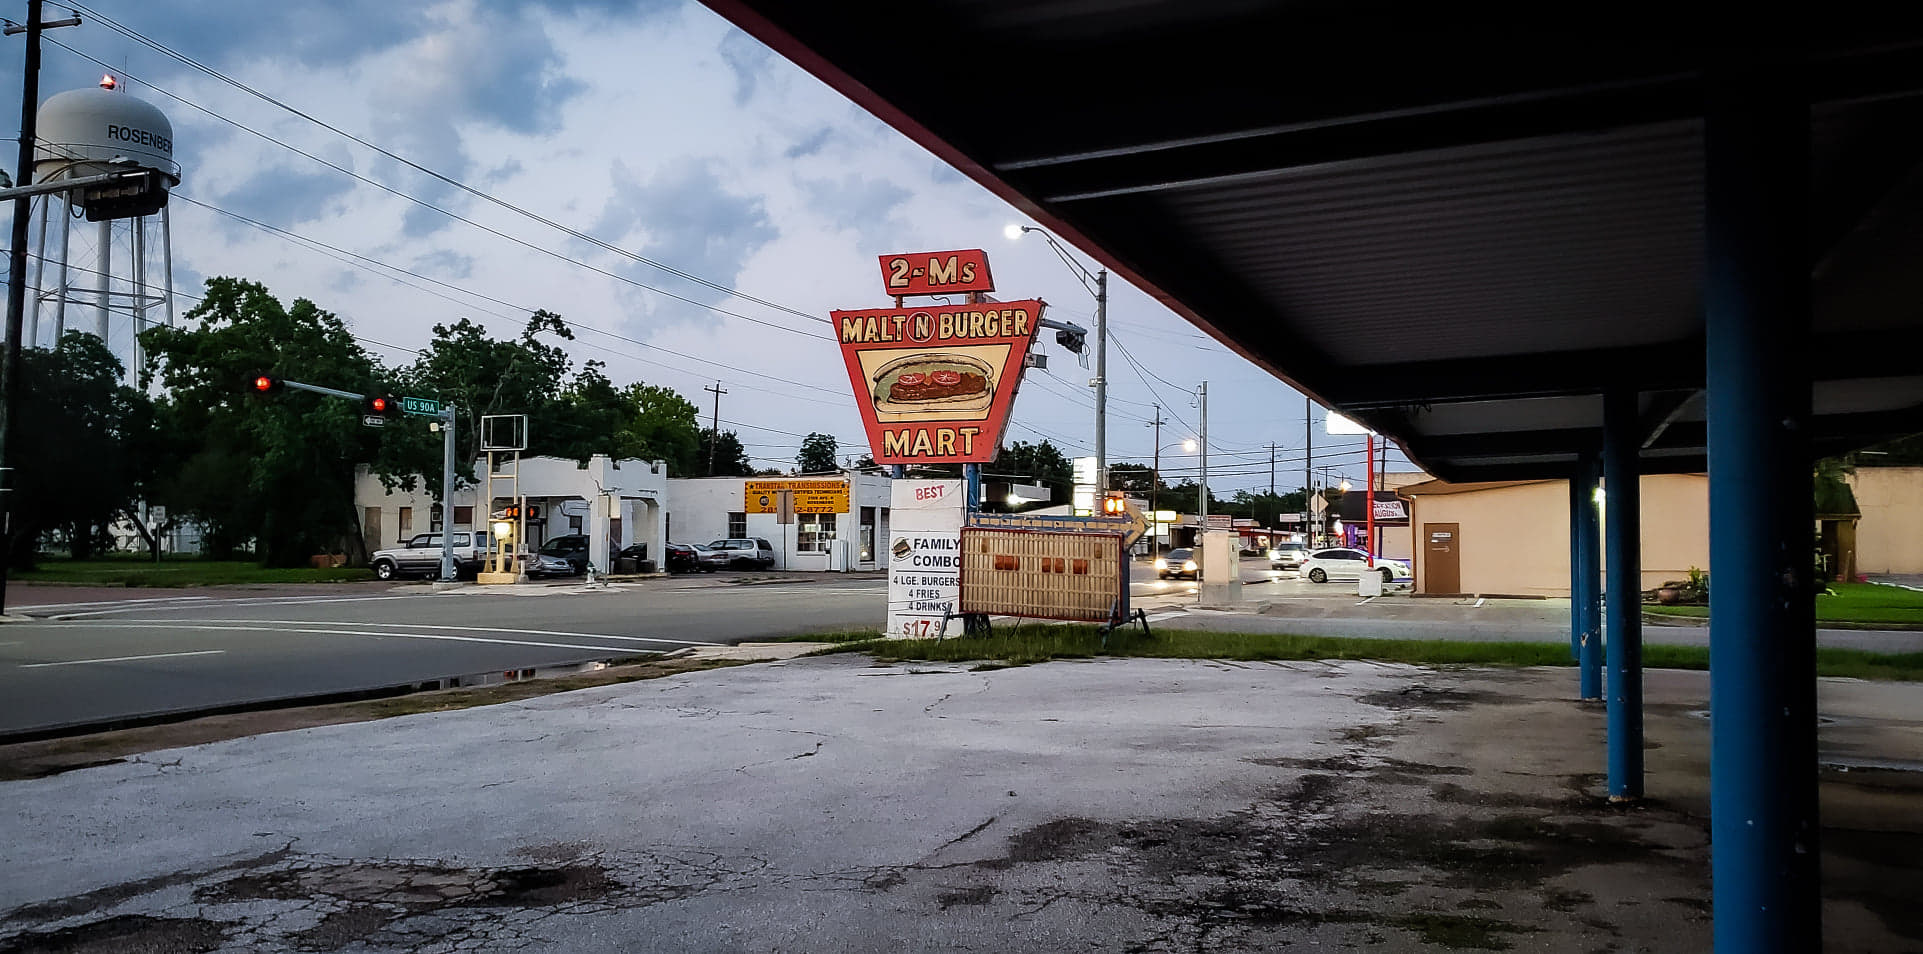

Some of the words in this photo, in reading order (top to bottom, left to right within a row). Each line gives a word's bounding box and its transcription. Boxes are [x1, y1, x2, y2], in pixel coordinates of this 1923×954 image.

[841, 315, 906, 344] MALT
[914, 316, 929, 339] N
[939, 309, 1029, 340] BURGER
[407, 400, 417, 410] US
[420, 402, 435, 412] 90A
[884, 428, 979, 458] MART
[916, 485, 944, 500] BEST
[914, 539, 960, 550] FAMILY
[913, 556, 960, 567] COMBO
[893, 576, 898, 585] 4
[901, 576, 919, 585] LGE.
[922, 577, 960, 586] BURGERS
[909, 589, 913, 598] 4
[916, 589, 940, 599] FRIES
[909, 602, 913, 611] 4
[916, 602, 947, 612] DRINKS
[903, 620, 947, 637] $17.9
